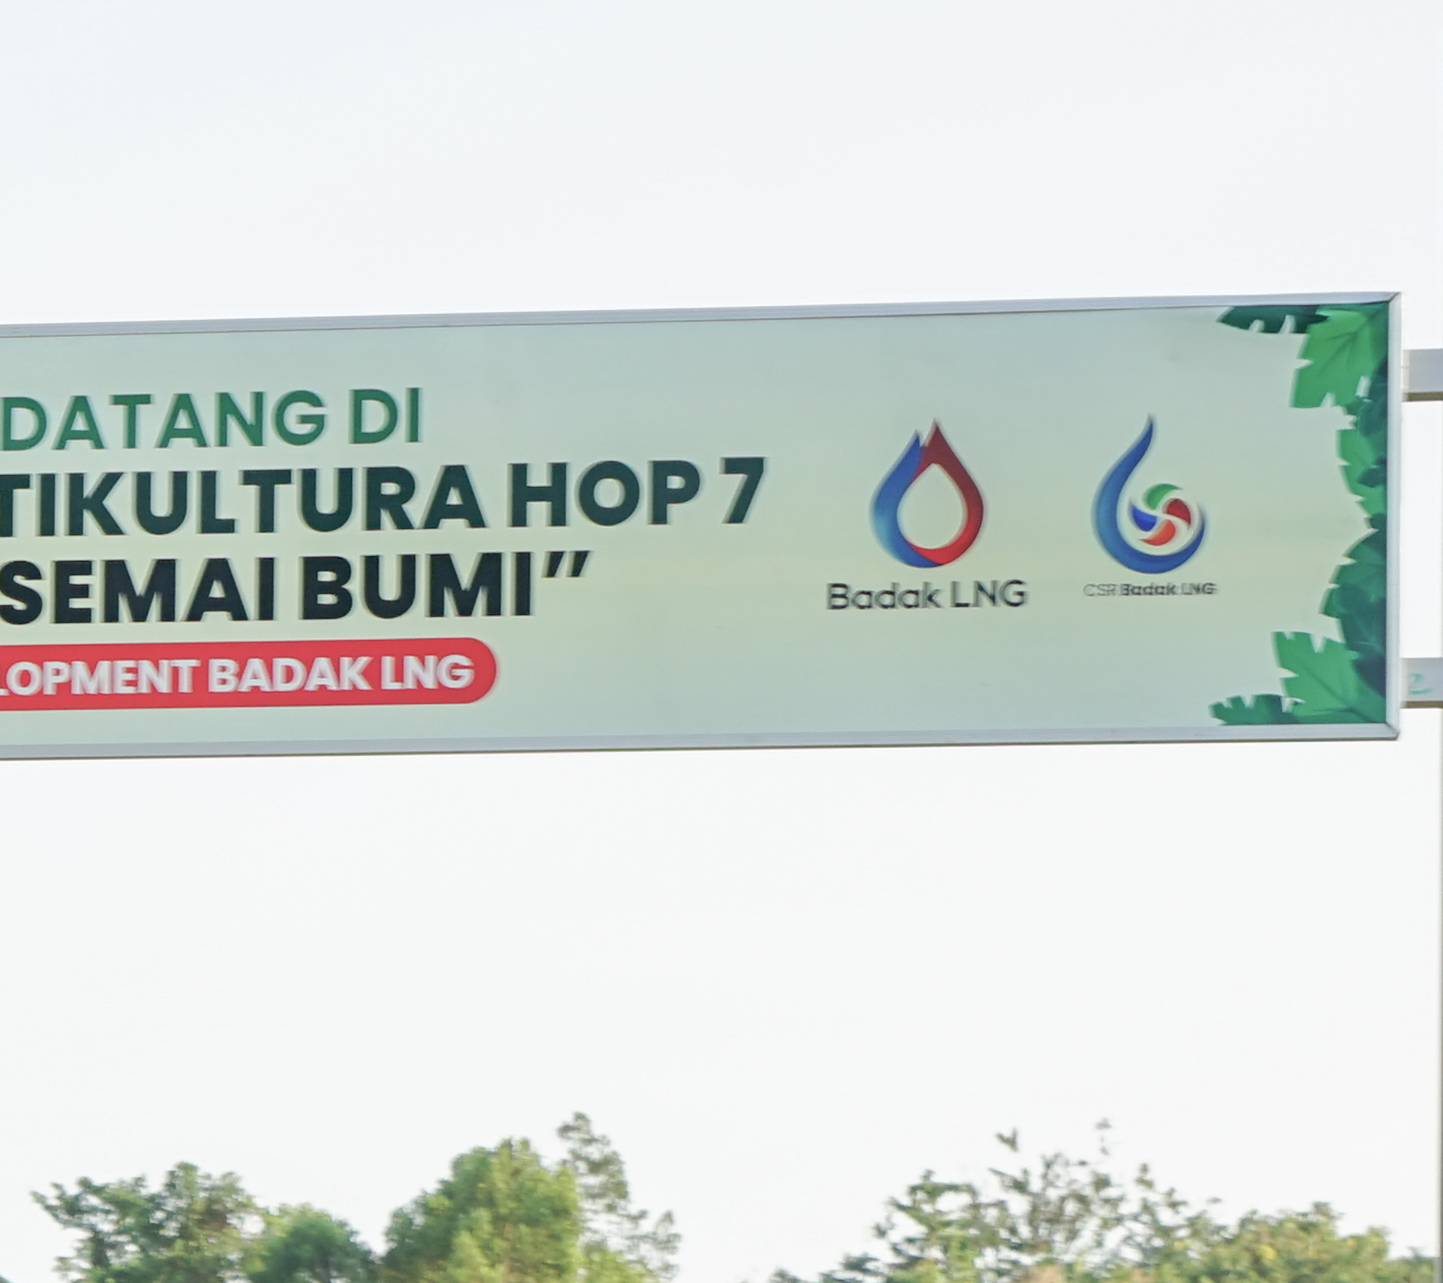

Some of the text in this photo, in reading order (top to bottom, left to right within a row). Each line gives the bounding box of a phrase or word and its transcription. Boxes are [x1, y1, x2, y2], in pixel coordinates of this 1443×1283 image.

[0, 389, 326, 452] DATANG
[349, 387, 421, 445] DI
[508, 459, 702, 528] HOP
[720, 456, 767, 525] 7
[827, 578, 1027, 611] Badak LNG
[1082, 582, 1218, 597] CSR Badak LNG
[208, 656, 374, 693] BADAK
[379, 654, 475, 690] LNG
